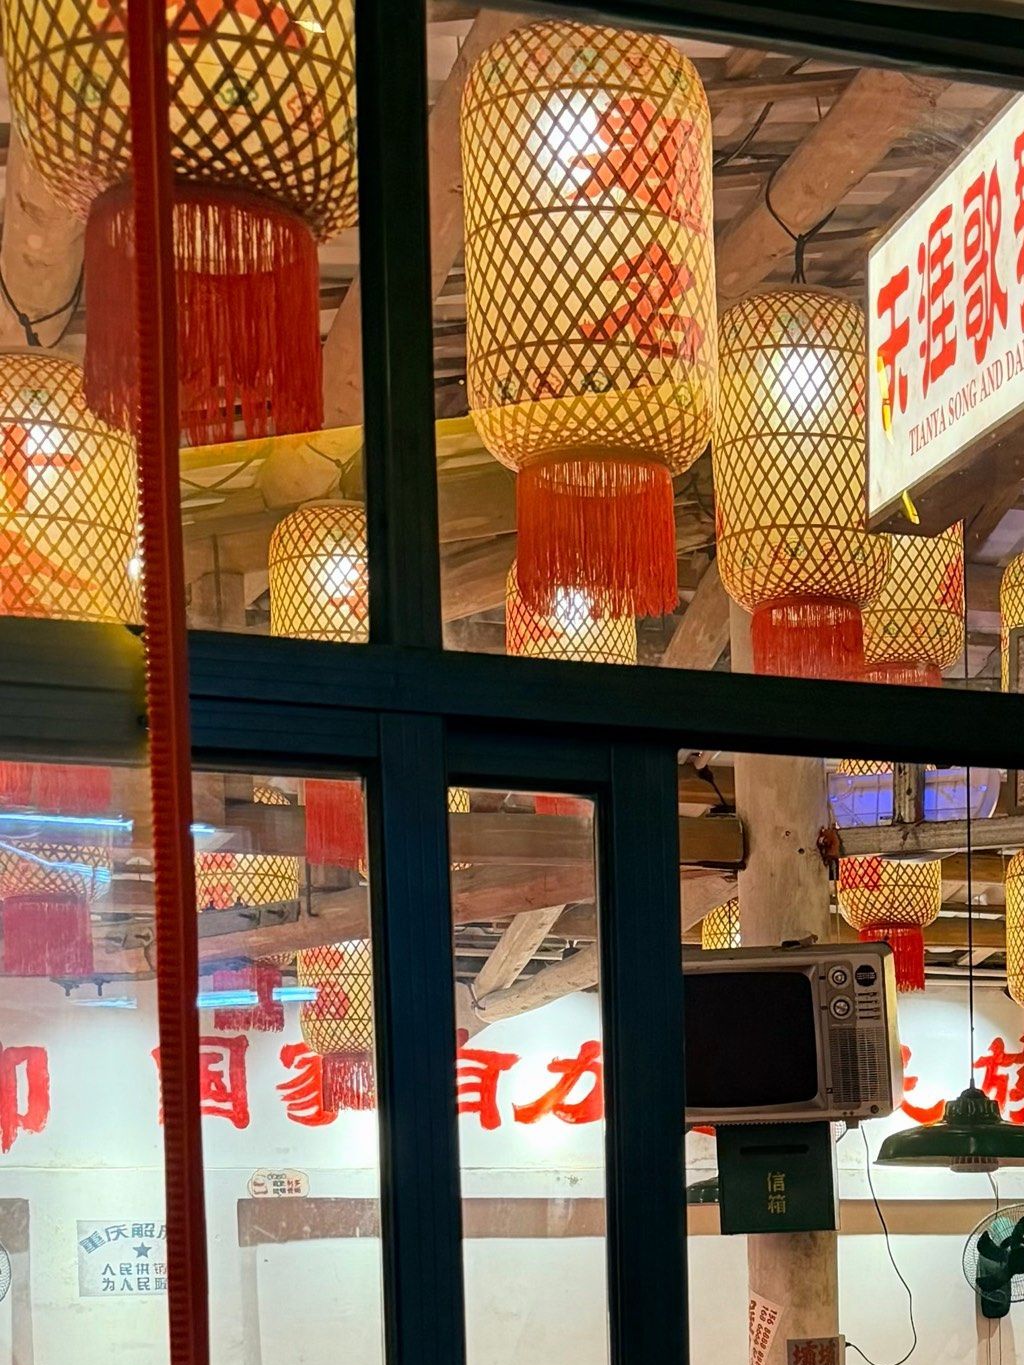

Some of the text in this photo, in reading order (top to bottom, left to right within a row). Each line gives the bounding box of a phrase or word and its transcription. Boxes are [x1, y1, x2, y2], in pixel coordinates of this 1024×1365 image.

[908, 406, 948, 457] TIANYA
[947, 378, 979, 428] SONG
[979, 356, 1005, 408] AND
[766, 1171, 787, 1215] 信箱
